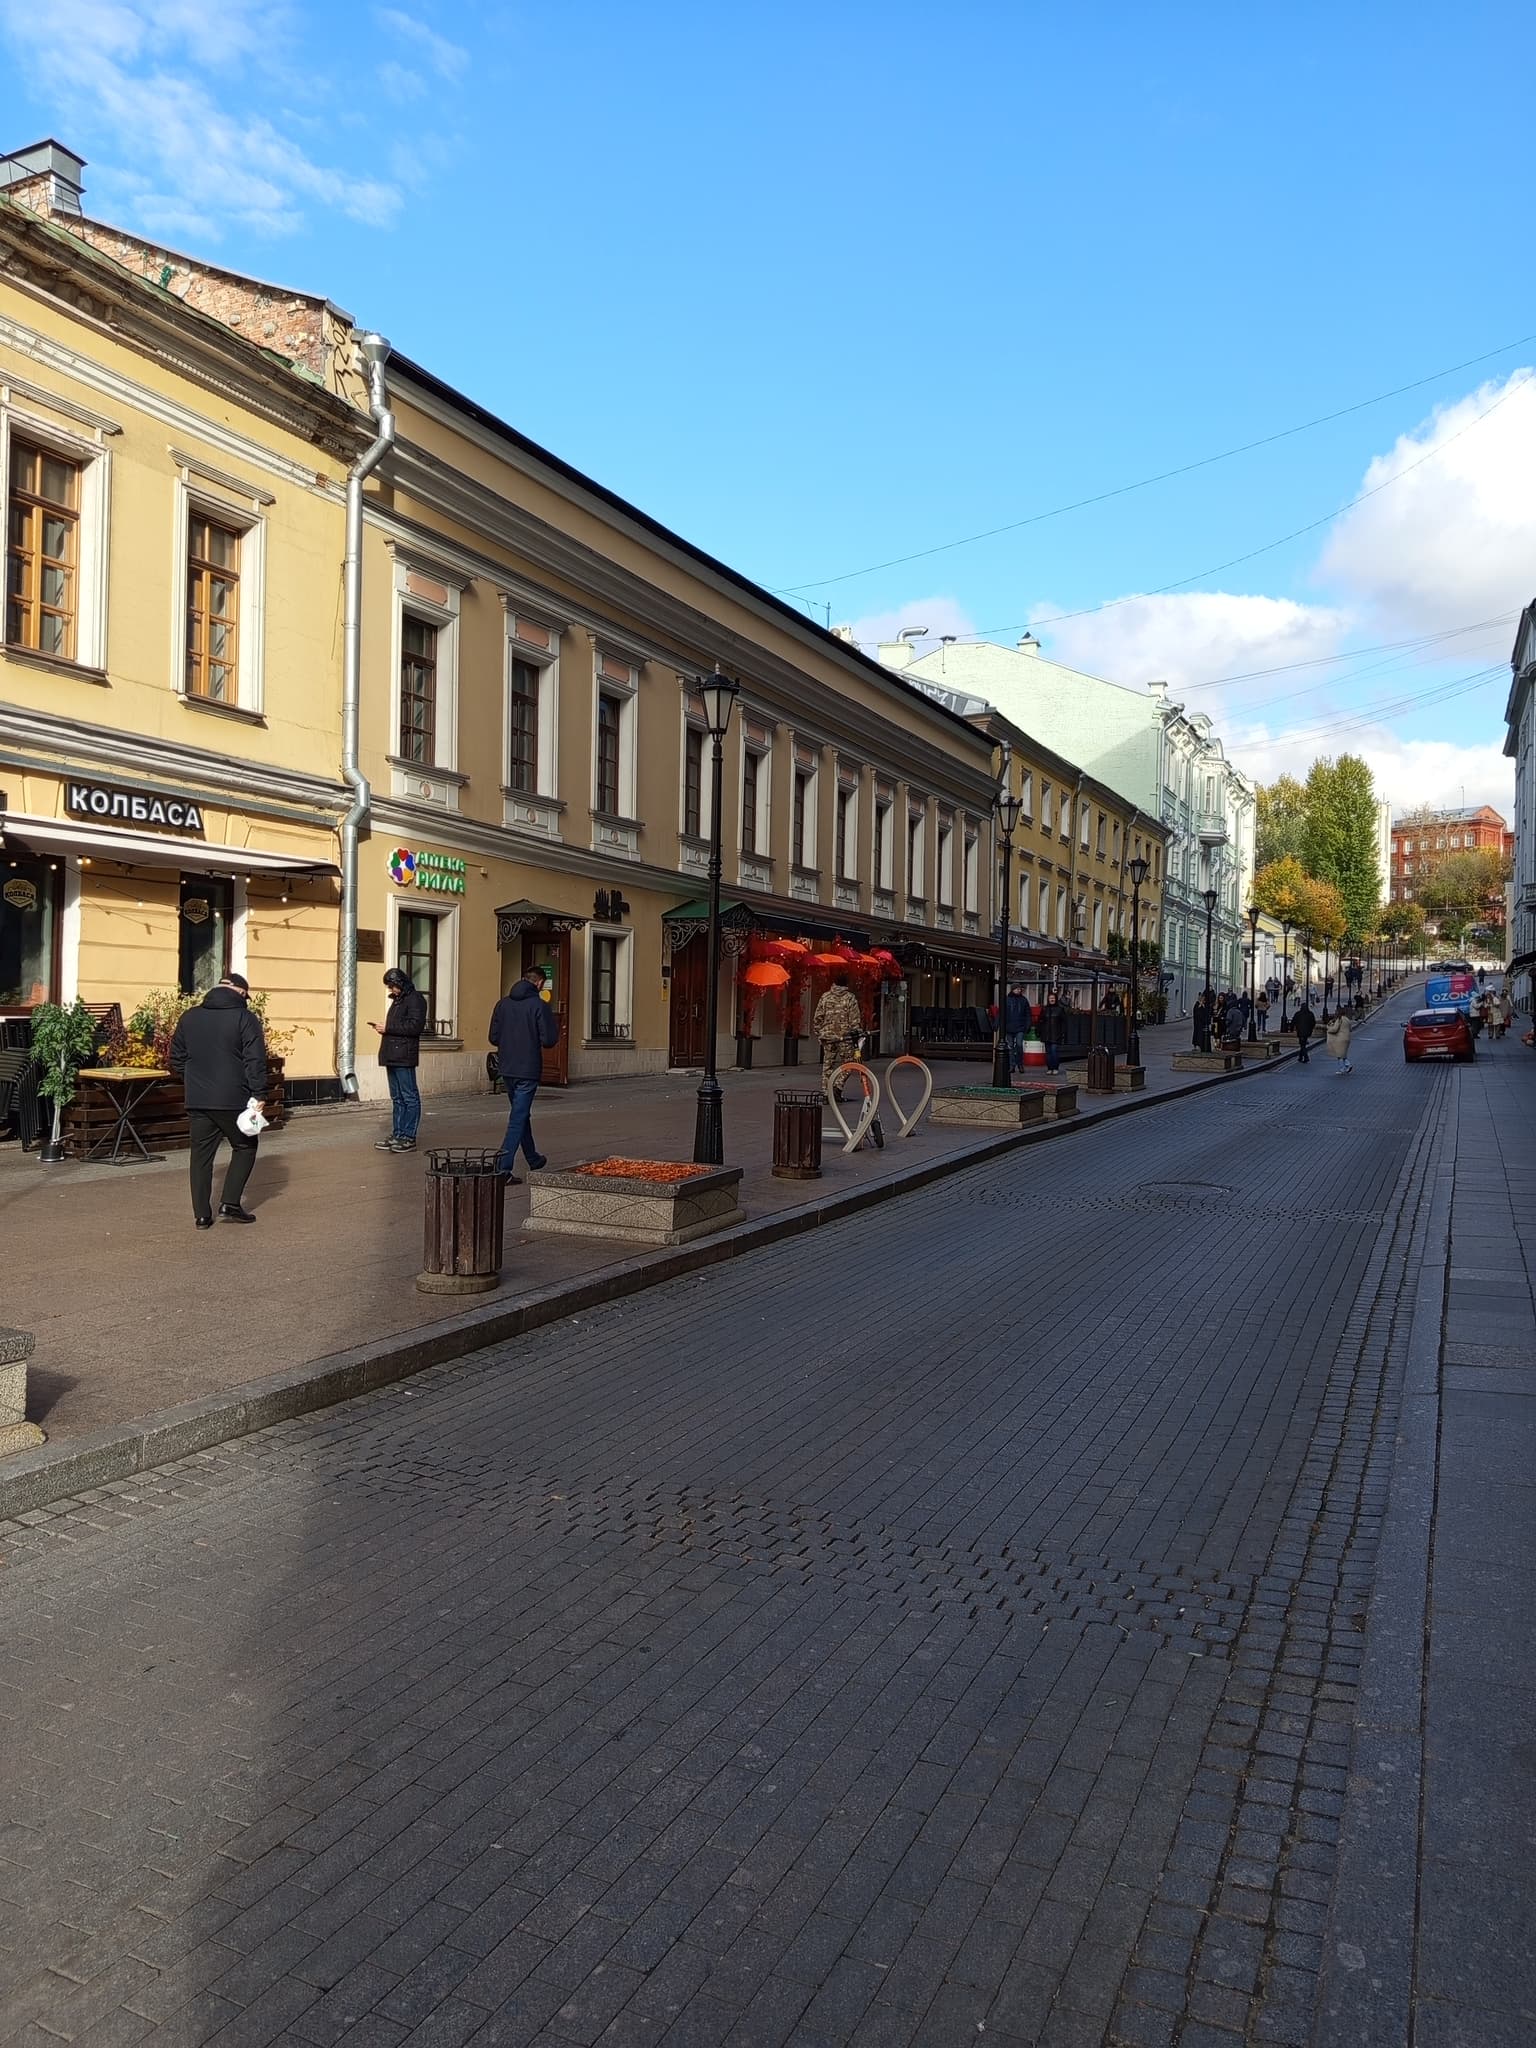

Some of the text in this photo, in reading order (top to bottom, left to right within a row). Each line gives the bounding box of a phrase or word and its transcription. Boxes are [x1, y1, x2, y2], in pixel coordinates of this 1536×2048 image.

[71, 786, 201, 828] КОЛБАСА
[415, 851, 466, 872] АПТЕКА
[415, 871, 466, 893] РИГЛА
[1432, 991, 1469, 1002] OZON
